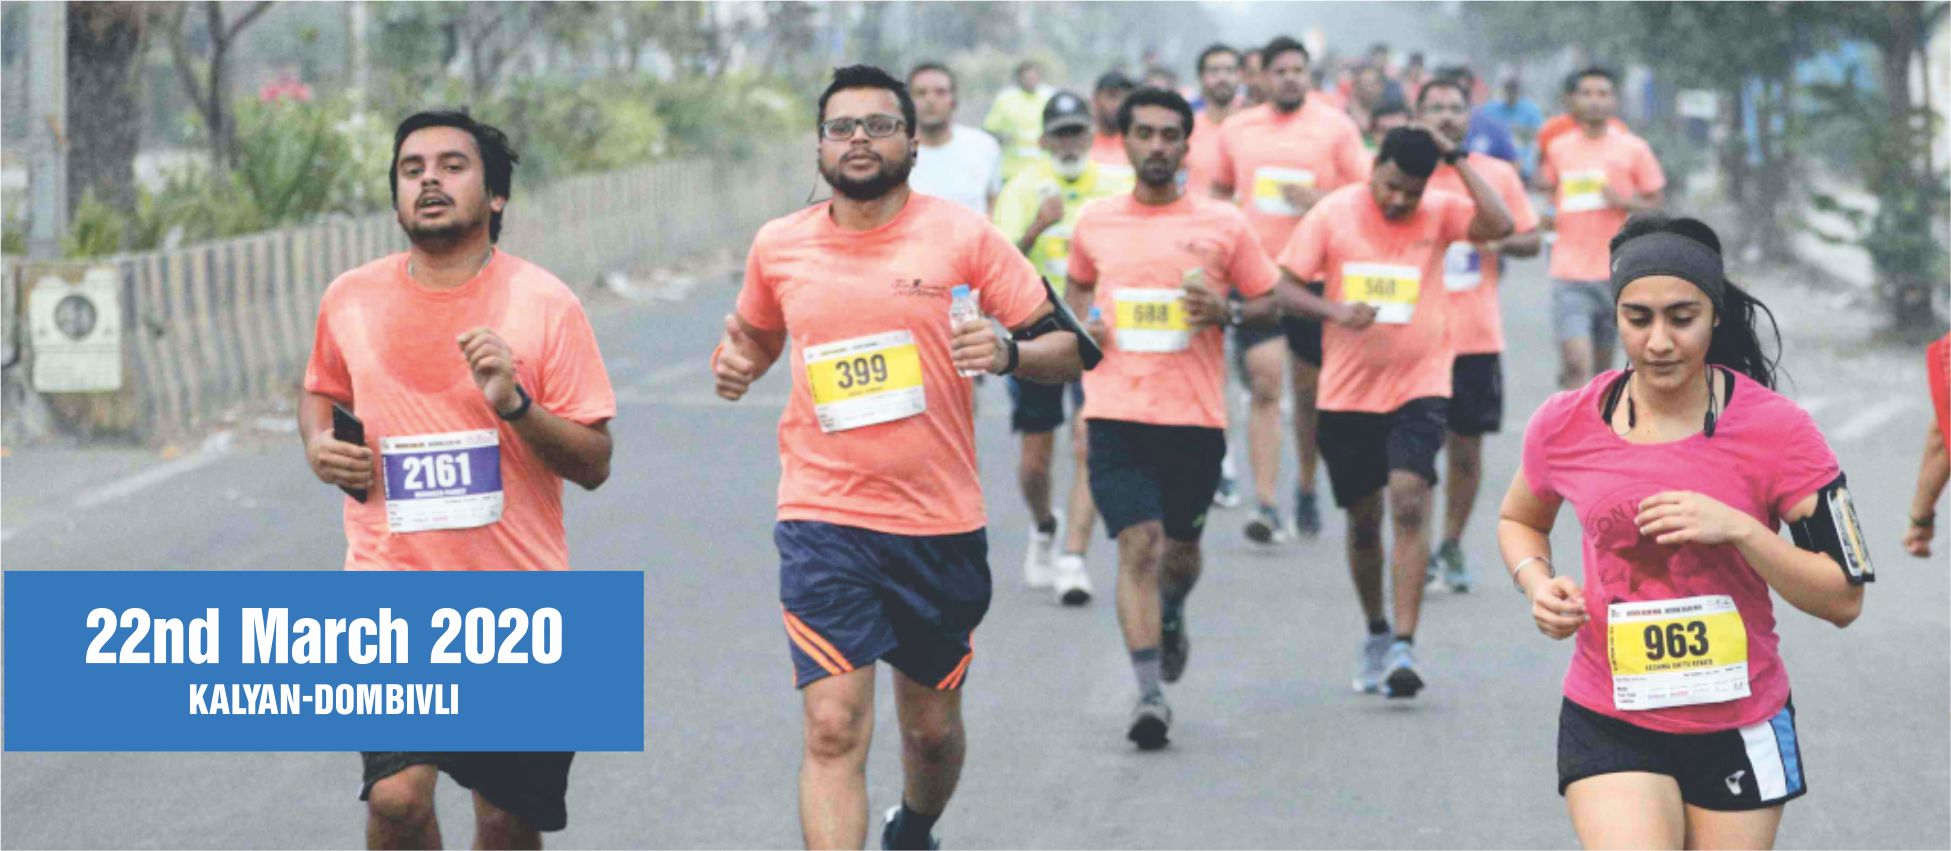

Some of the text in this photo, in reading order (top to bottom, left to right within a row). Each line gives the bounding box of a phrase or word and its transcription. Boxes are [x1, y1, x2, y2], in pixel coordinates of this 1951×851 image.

[835, 353, 888, 390] 399
[401, 452, 472, 490] 2161
[1644, 620, 1709, 661] 963
